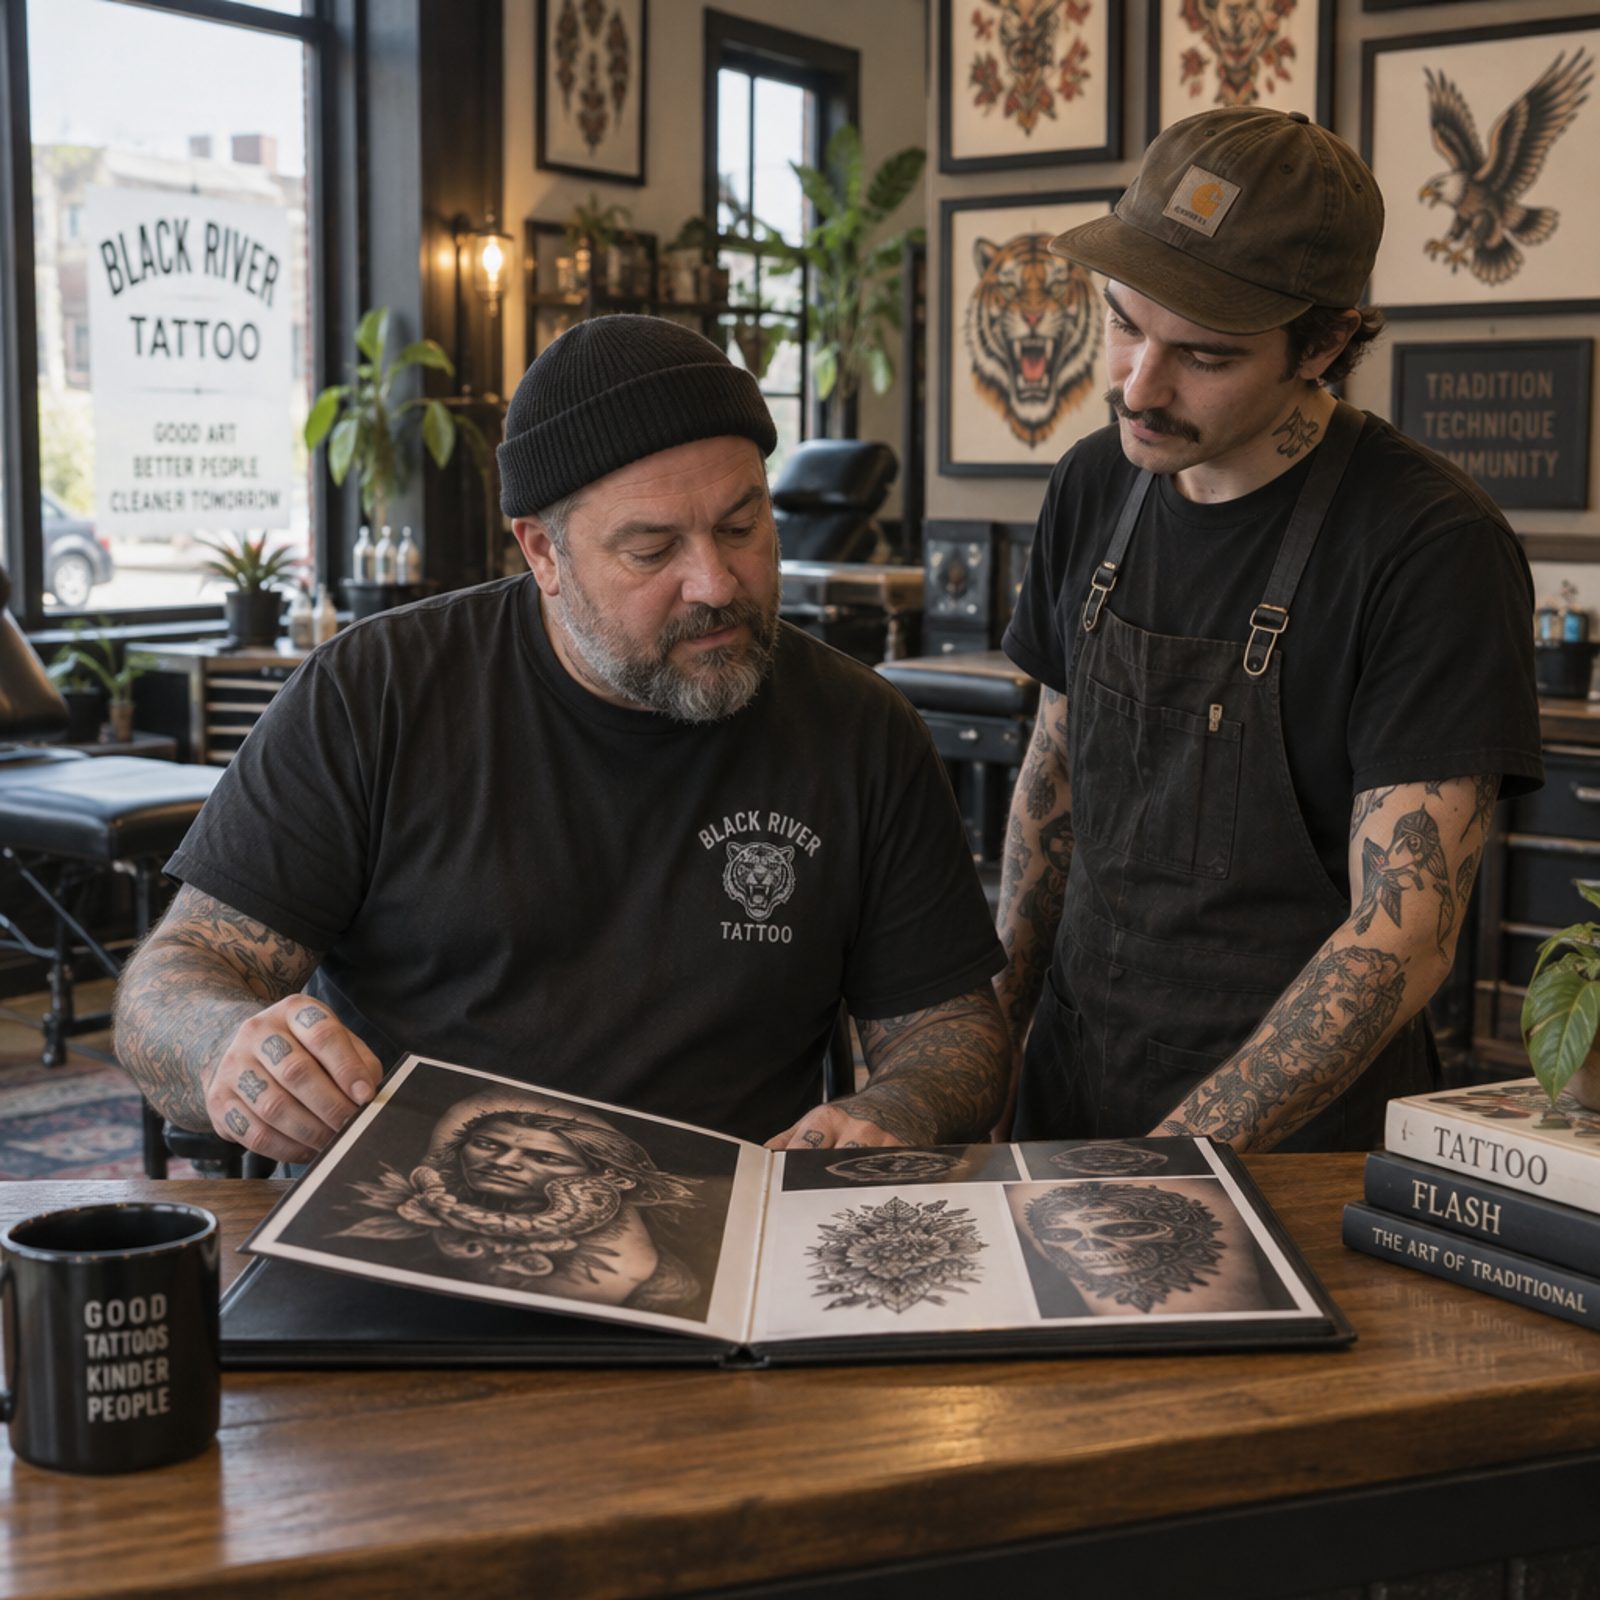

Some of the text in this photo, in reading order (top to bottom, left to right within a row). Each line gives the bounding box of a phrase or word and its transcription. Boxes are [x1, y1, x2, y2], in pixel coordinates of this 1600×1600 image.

[99, 219, 280, 308] BLACK RIVER
[129, 316, 260, 361] TATTOO
[1425, 370, 1553, 400] TRADITION
[153, 422, 237, 444] GOOD ART
[1423, 410, 1555, 441] TECHNIQUE
[133, 456, 259, 479] BETTER PEOPLE
[1445, 449, 1560, 479] MMUNITY
[110, 489, 281, 513] CLEANER TOMORROW
[698, 810, 822, 858] BLACK RIVER
[720, 921, 792, 944] TATTOO
[1434, 1126, 1548, 1186] TATTOO
[1412, 1179, 1501, 1235] FLASH
[1372, 1227, 1587, 1313] THE ART OF TRADITIONAL
[84, 1294, 167, 1328] GOOD
[84, 1324, 169, 1360] TATTOOS
[86, 1356, 169, 1392] KINDER
[87, 1388, 170, 1423] PEOPLE
